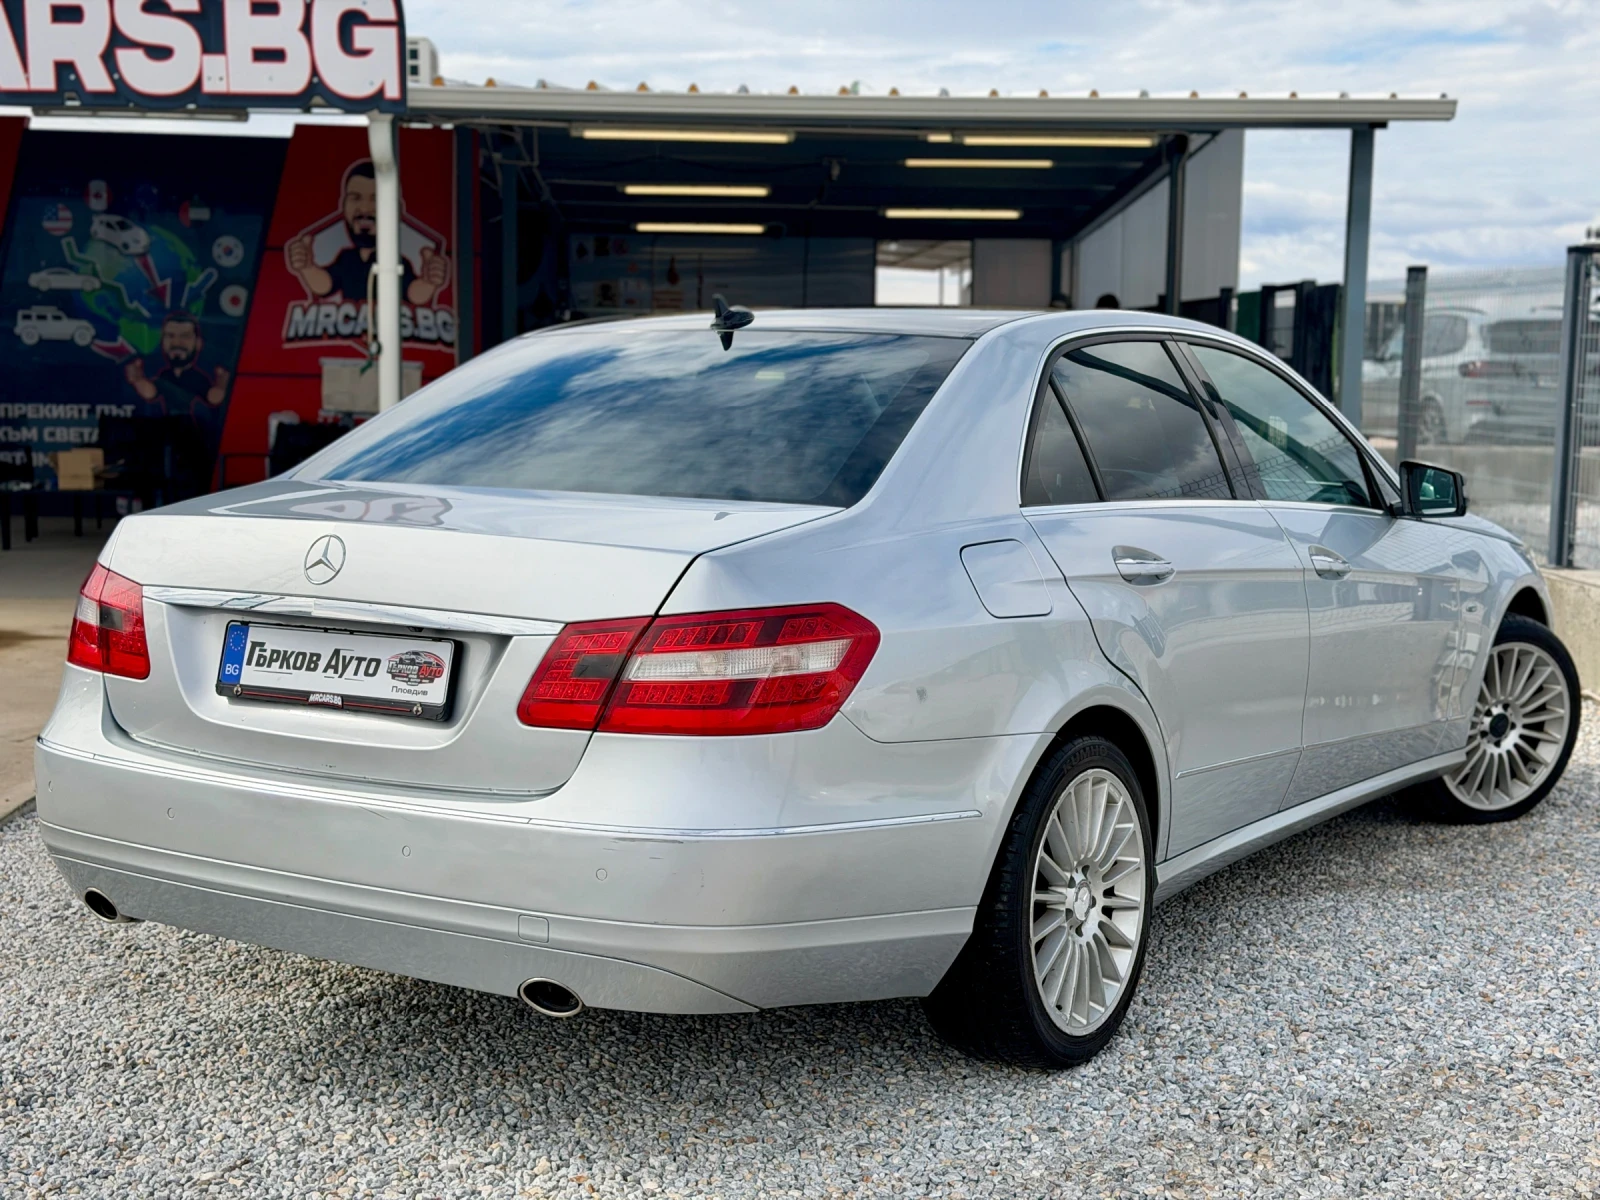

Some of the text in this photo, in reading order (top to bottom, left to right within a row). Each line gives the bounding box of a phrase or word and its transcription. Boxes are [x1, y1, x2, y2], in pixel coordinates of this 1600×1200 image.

[287, 303, 455, 343] MRCAS.BG
[225, 663, 240, 677] BG
[391, 685, 429, 697] Пловдив
[1063, 745, 1108, 774] KUMHO
